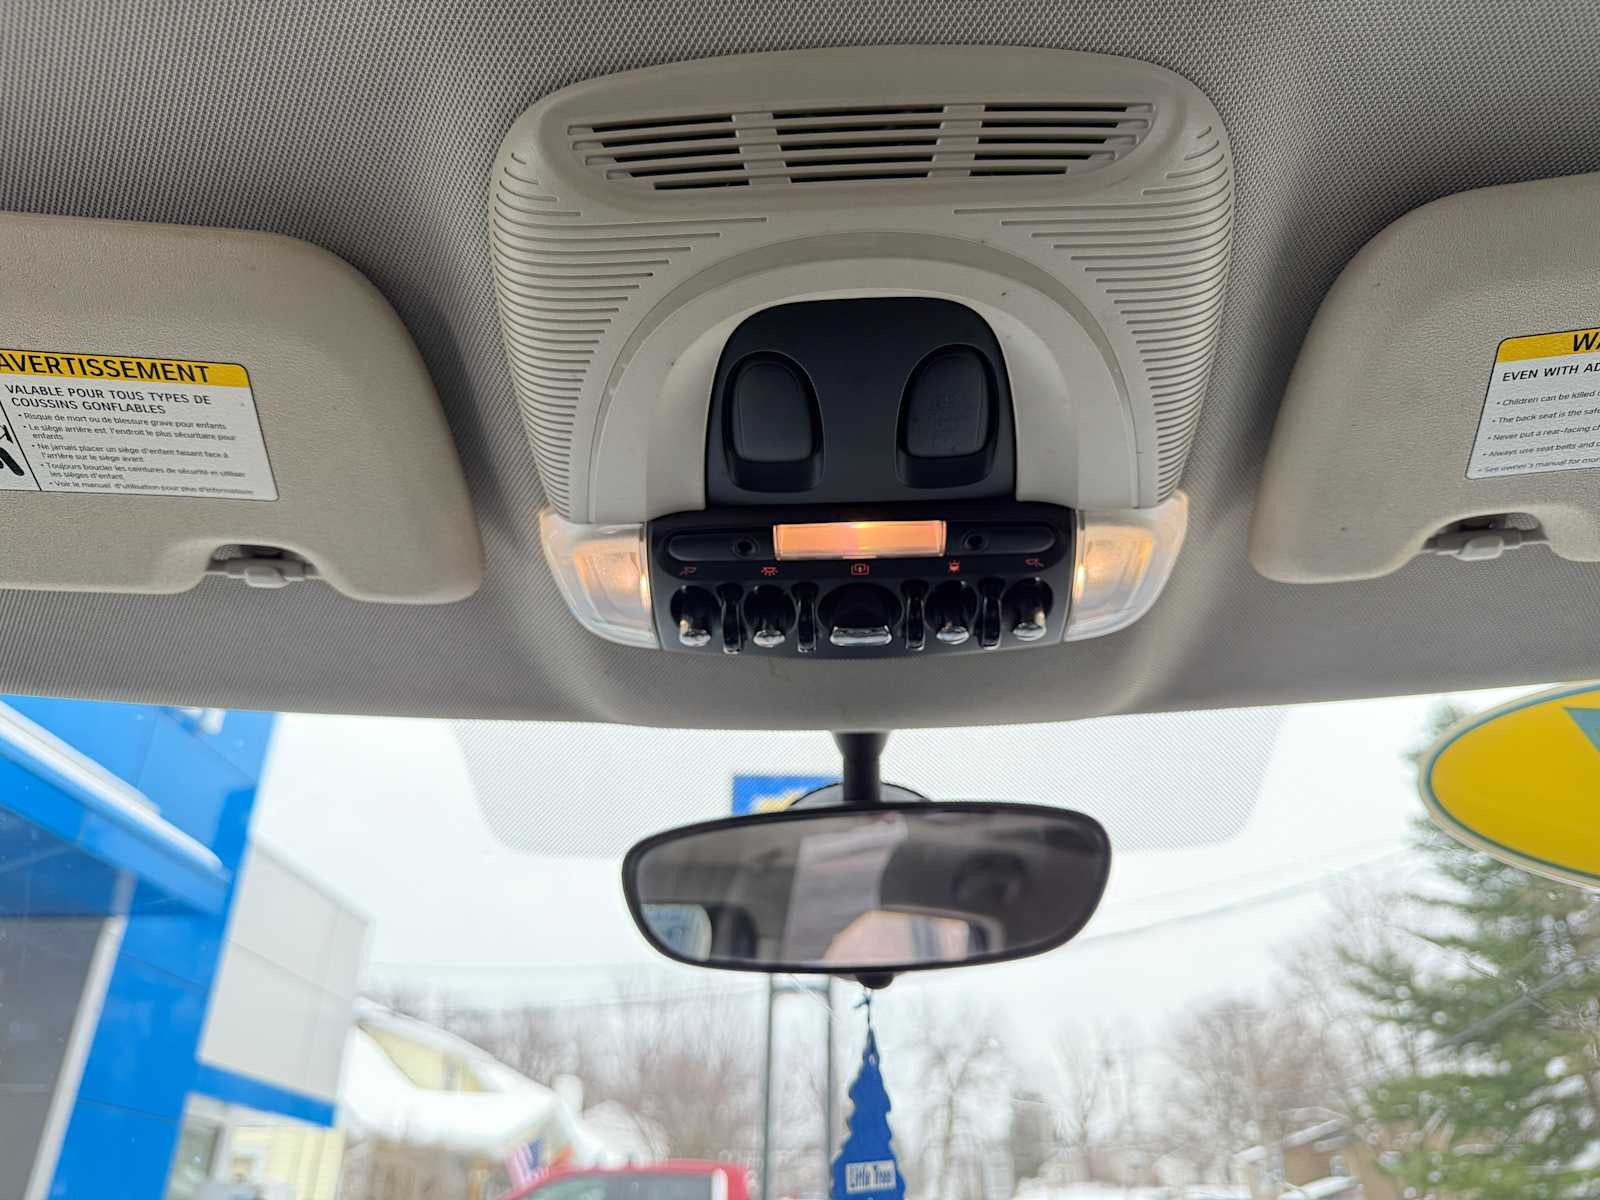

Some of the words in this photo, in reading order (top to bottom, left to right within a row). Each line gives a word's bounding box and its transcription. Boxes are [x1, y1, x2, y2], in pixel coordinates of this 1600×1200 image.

[1573, 332, 1600, 352] W
[1502, 369, 1538, 382] EVEN
[1544, 364, 1579, 378] WITH
[5, 384, 64, 397] VALABLE
[68, 388, 104, 399] POUR
[109, 390, 144, 401] TOUS
[148, 392, 190, 404] TYPES
[193, 394, 212, 405] DE
[1502, 396, 1539, 407] Children
[1540, 394, 1557, 402] can
[1571, 390, 1596, 400] killed
[12, 397, 78, 410] COUSSINS
[82, 401, 166, 414] GONFLABLES
[24, 412, 52, 422] Risque
[66, 414, 87, 422] mort
[114, 417, 148, 426] blessure
[1516, 414, 1536, 422] back
[40, 424, 62, 432] siège
[1492, 434, 1518, 442] Never
[1519, 431, 1534, 439] put
[1542, 426, 1590, 436] rear-facing
[51, 444, 78, 452] jamais
[1488, 449, 1518, 458] Always
[1536, 445, 1554, 453] seat
[1554, 443, 1576, 451] belts
[1578, 440, 1596, 448] and
[46, 462, 81, 472] Toujours
